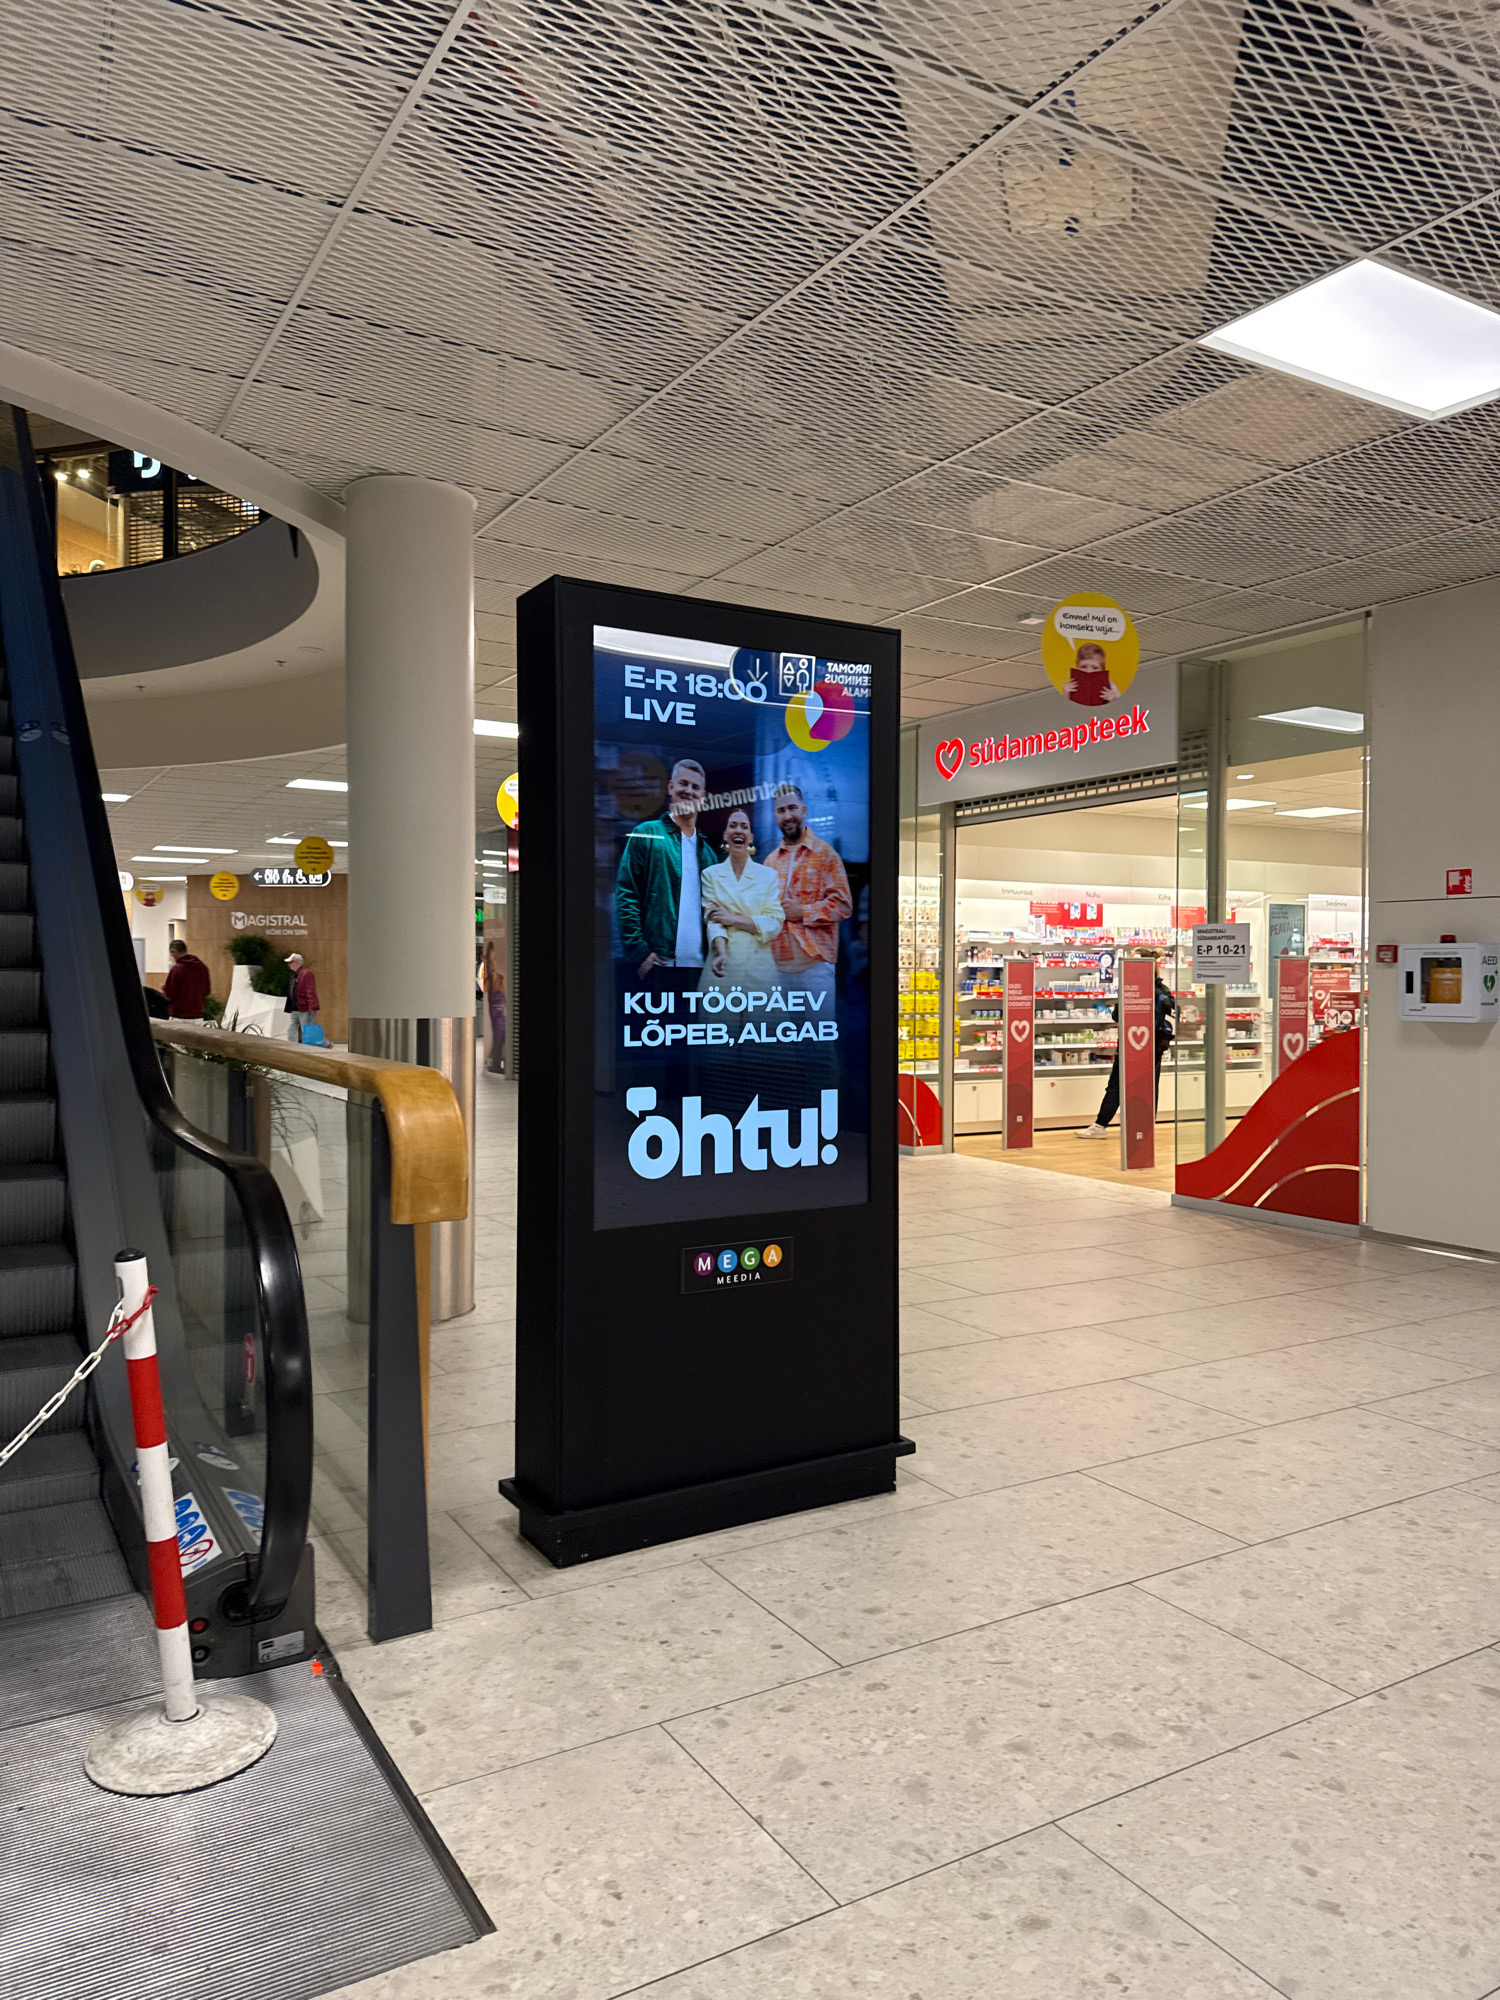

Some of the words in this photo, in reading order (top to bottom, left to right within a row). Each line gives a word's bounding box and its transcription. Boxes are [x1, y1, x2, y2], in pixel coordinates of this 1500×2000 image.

[1060, 622, 1094, 632] homseks
[1092, 615, 1105, 623] Mul
[624, 664, 678, 693] E-R
[684, 672, 768, 703] 18:00
[624, 696, 696, 726] LIVE
[968, 704, 1150, 768] südameapteek
[230, 911, 308, 930] MAGISTRAL
[1196, 945, 1213, 955] E-P
[1216, 944, 1246, 955] 10-21
[1482, 955, 1498, 966] AED
[624, 991, 675, 1015] KUI
[682, 985, 827, 1014] TÖÖPÄEV
[623, 1018, 735, 1048] LÕPEB,
[738, 1020, 839, 1044] ALGAB
[696, 1247, 780, 1274] MEGA
[716, 1272, 761, 1285] MEEDIA
